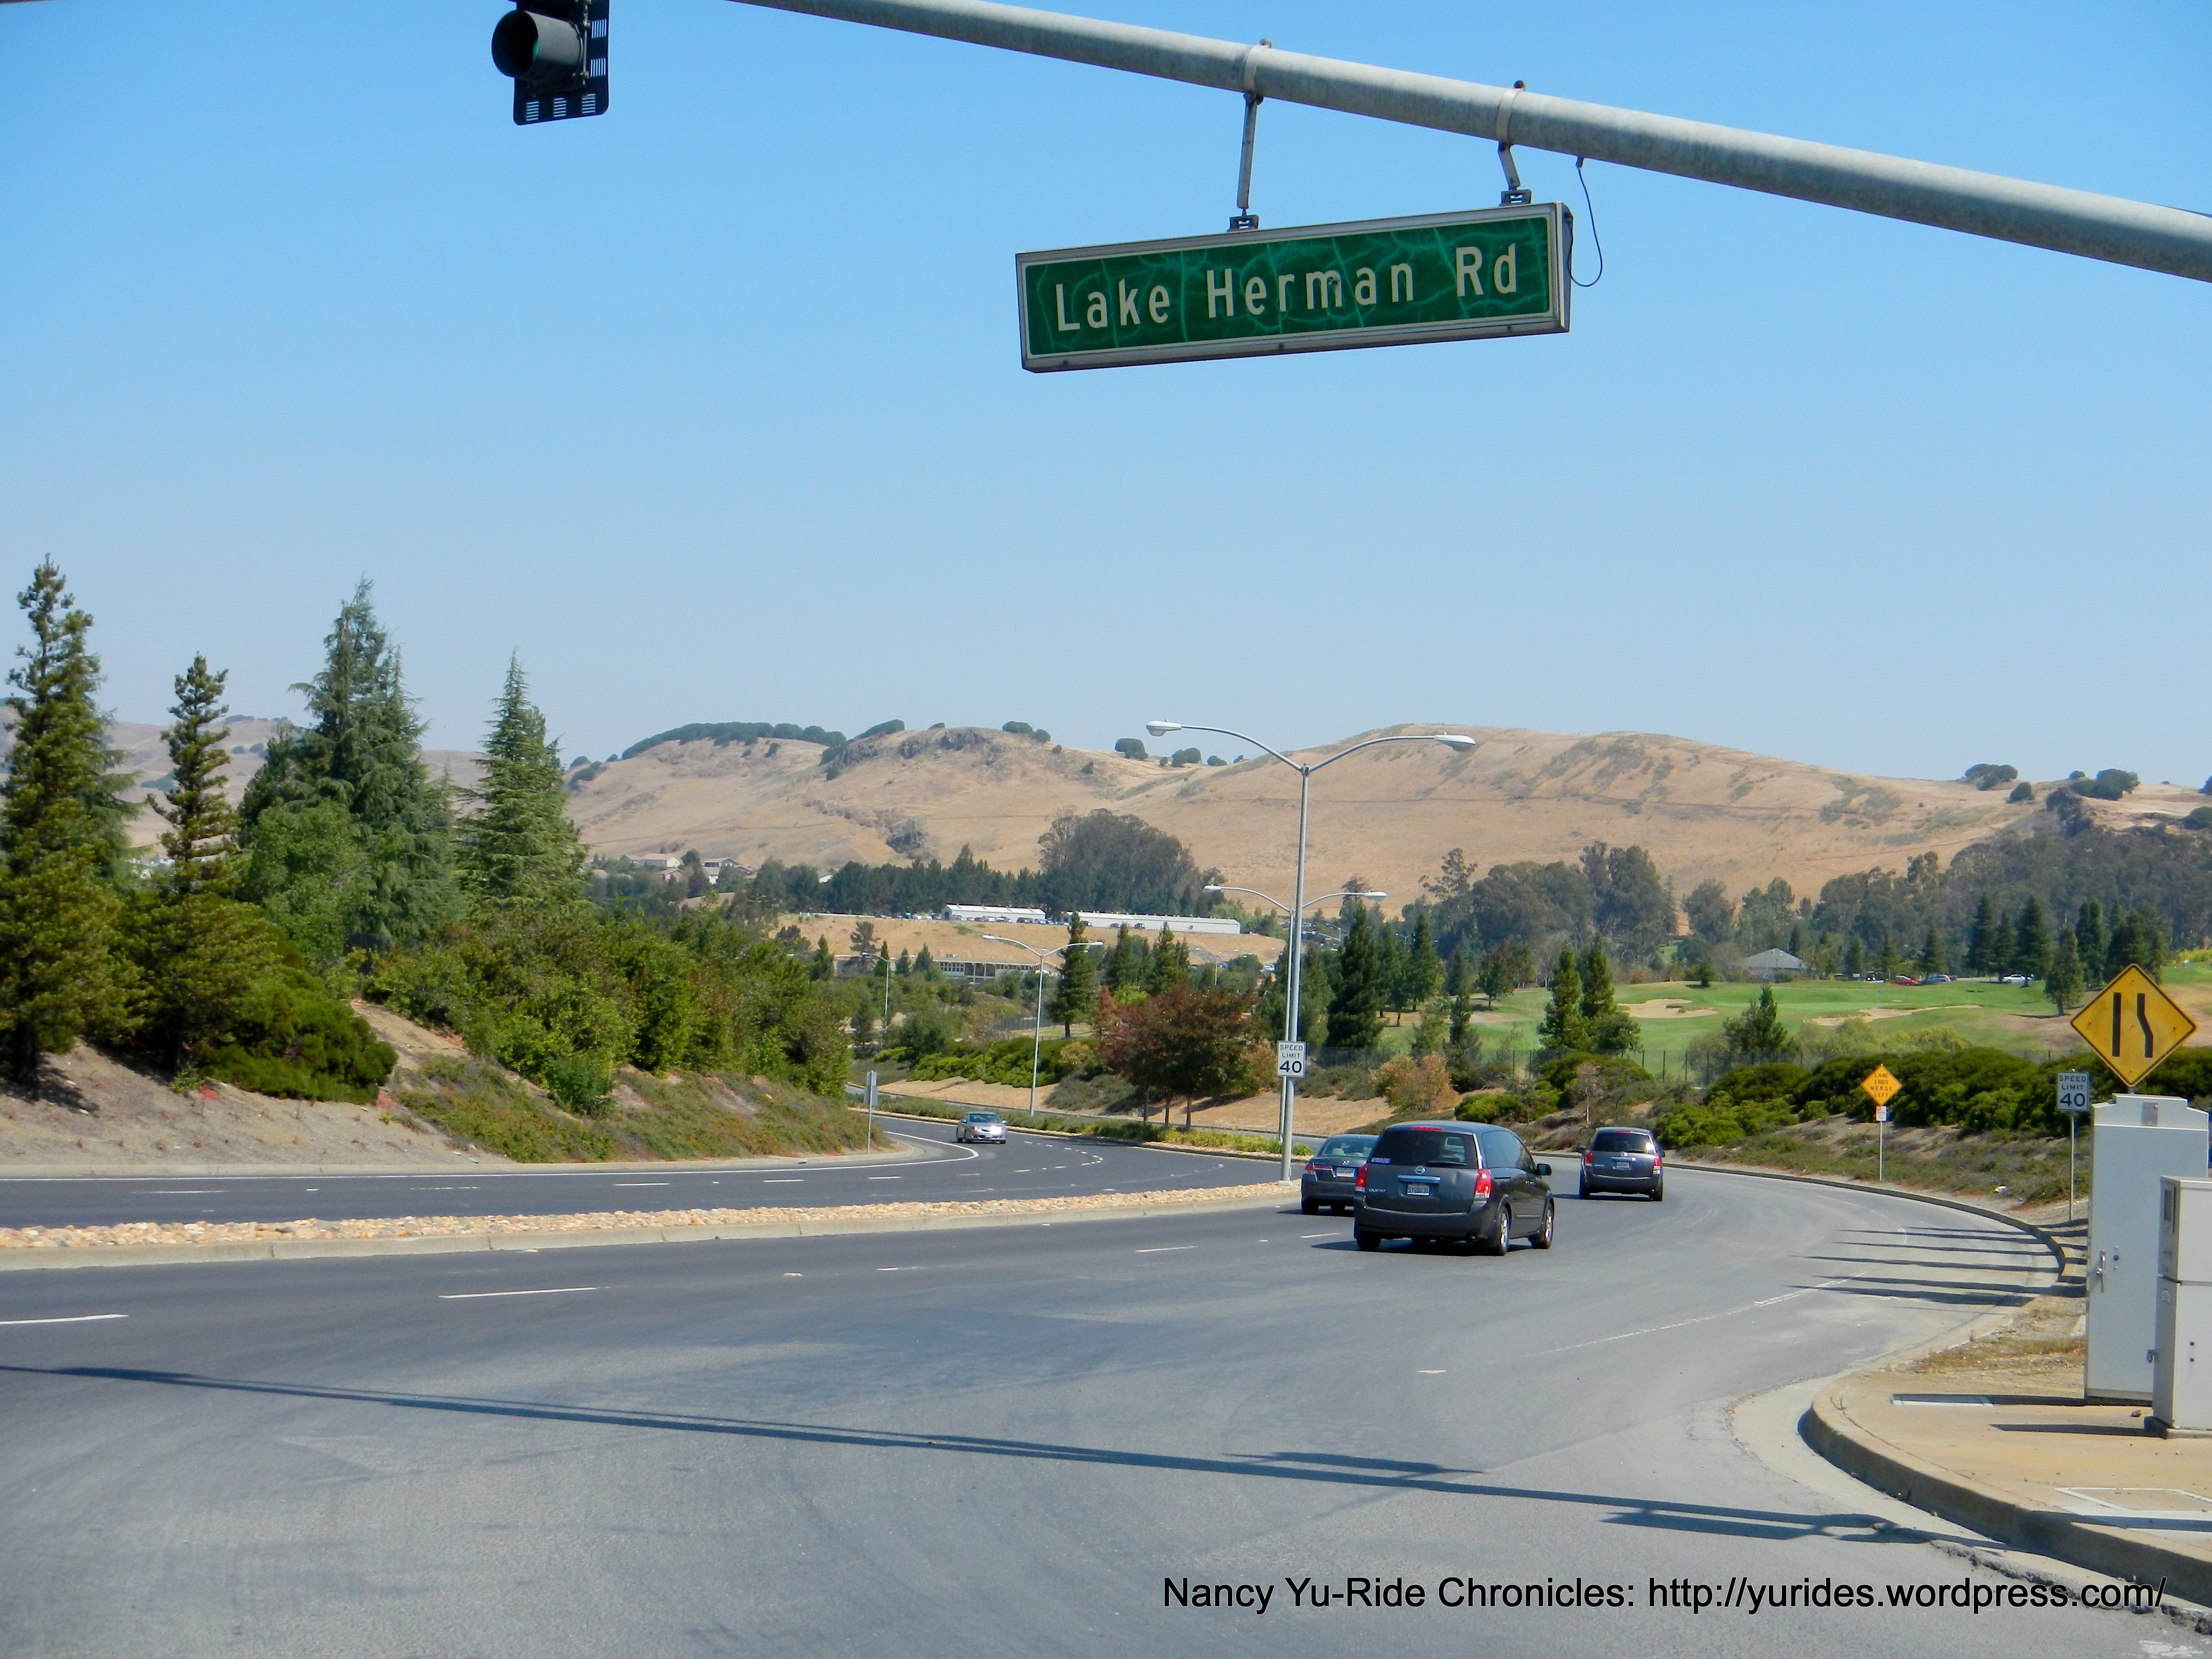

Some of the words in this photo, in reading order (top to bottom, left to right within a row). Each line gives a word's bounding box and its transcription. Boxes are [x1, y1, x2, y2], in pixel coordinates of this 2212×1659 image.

[1056, 278, 1170, 332] Lake
[1206, 262, 1414, 318] Herman
[1455, 243, 1516, 297] Rd
[1279, 1060, 1302, 1073] 40
[2059, 1093, 2086, 1107] 40
